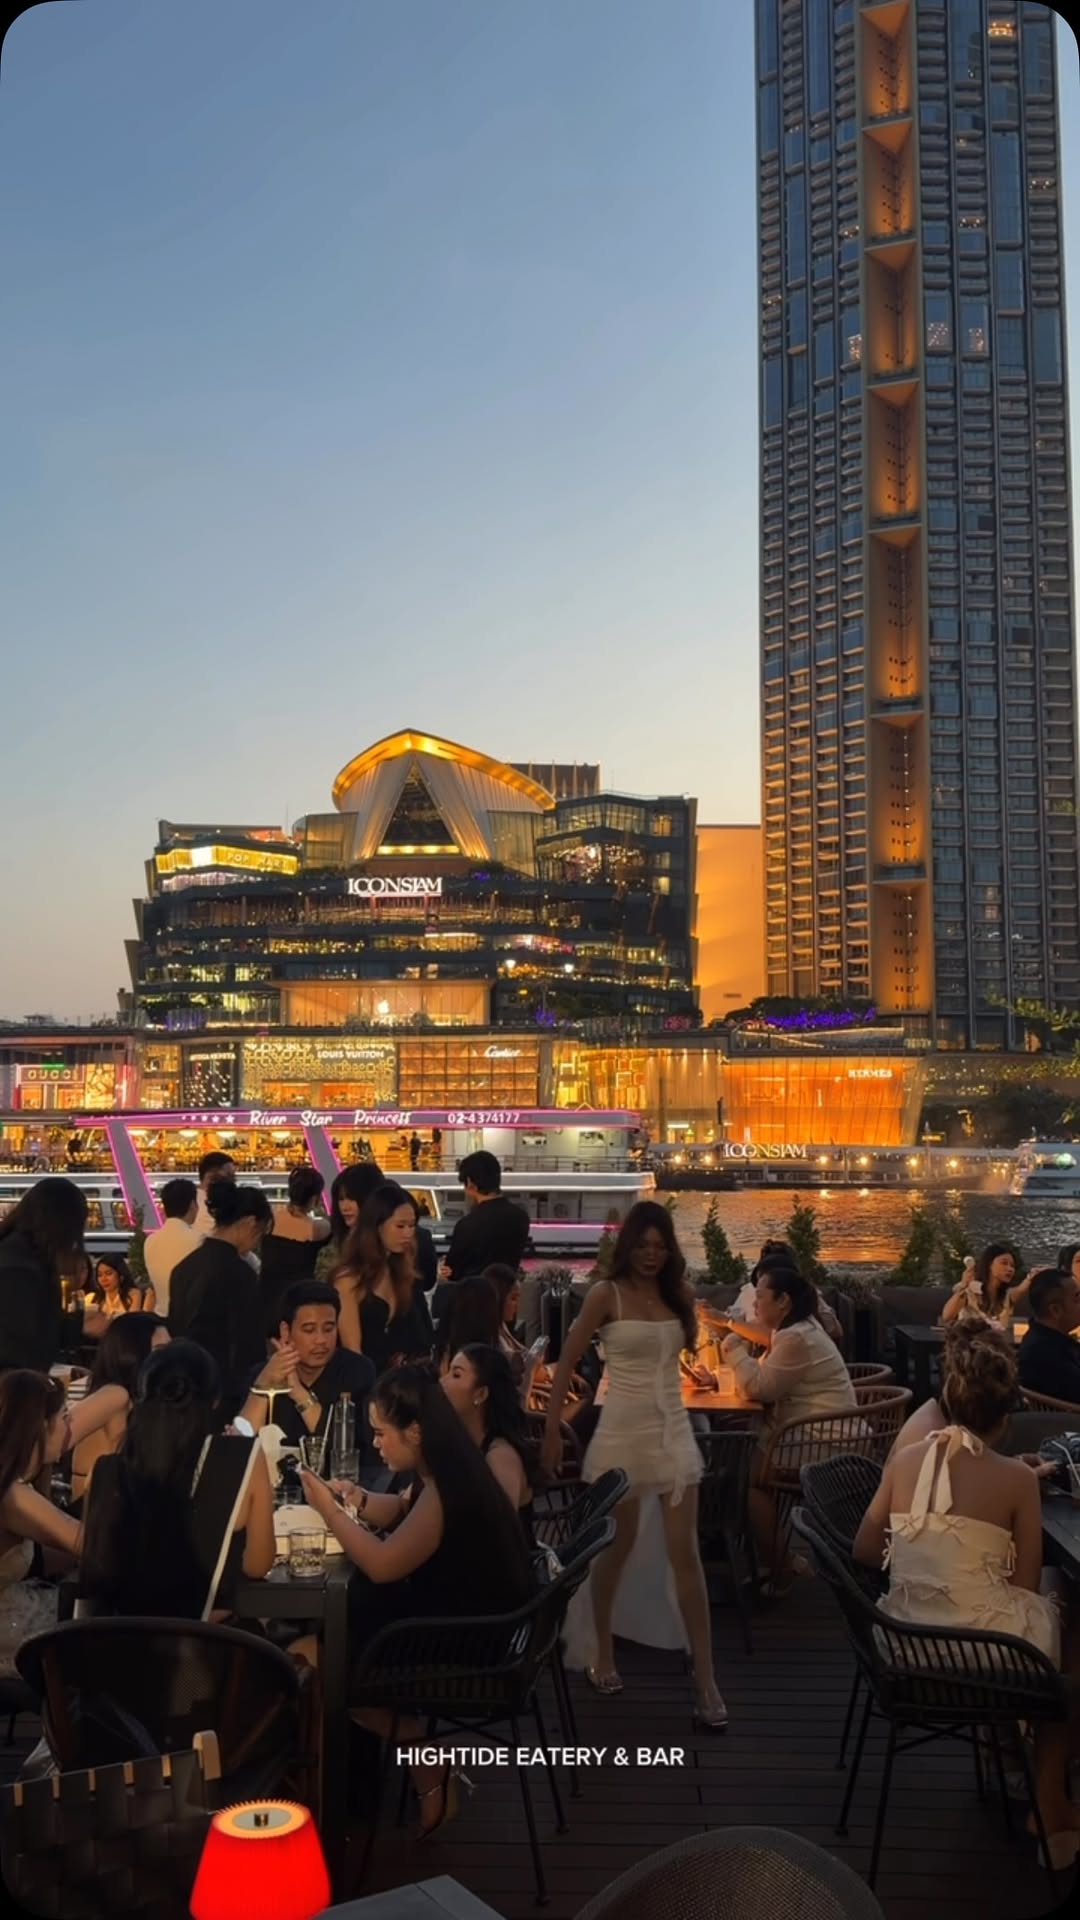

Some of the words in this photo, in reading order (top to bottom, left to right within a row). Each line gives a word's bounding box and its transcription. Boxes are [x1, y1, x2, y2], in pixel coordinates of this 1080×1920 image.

[347, 877, 443, 895] ICONSIAM
[317, 1050, 344, 1059] LOUIS
[250, 1110, 287, 1125] River
[299, 1110, 333, 1127] Star
[724, 1143, 807, 1158] ICONSIAM
